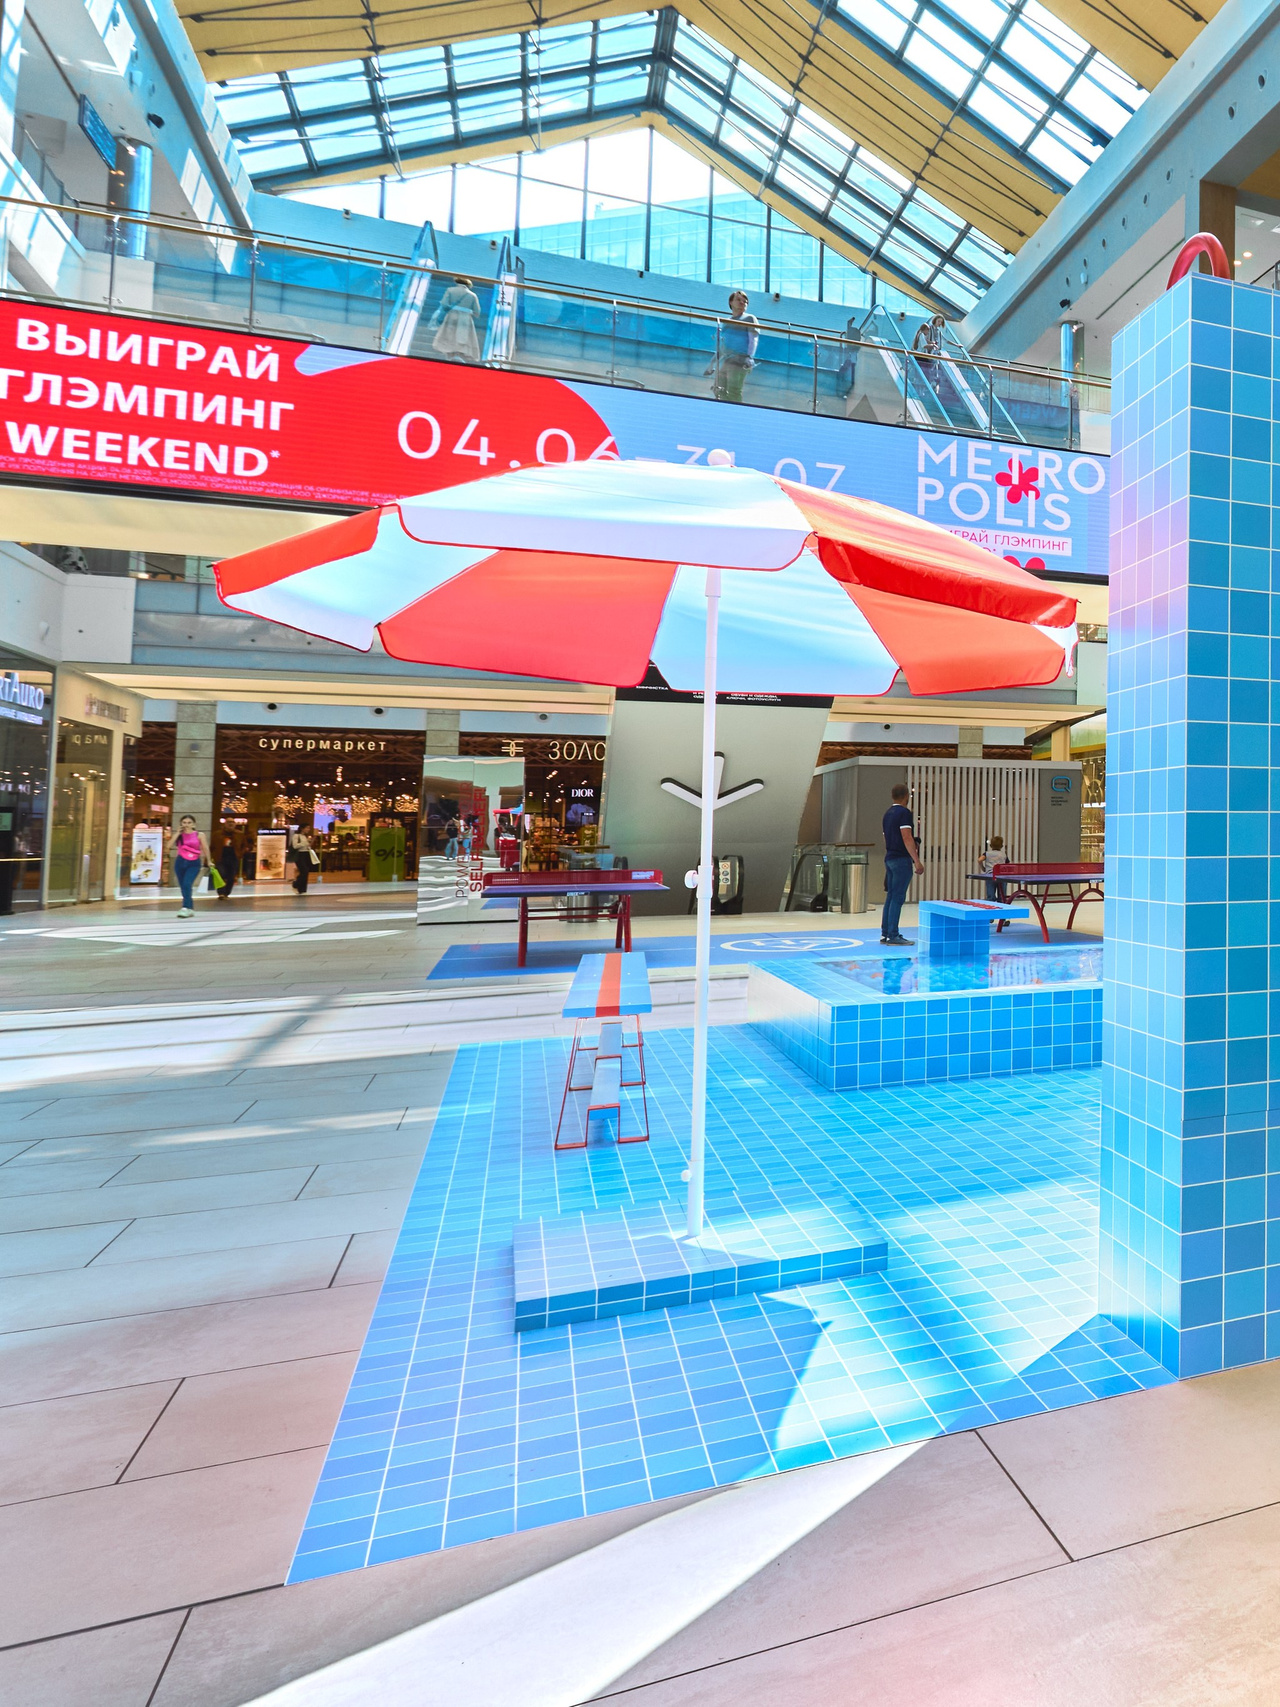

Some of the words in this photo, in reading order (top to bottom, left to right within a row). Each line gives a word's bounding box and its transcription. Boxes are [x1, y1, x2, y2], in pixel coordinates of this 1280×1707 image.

[16, 318, 280, 382] ВЫИГРАЙ
[0, 367, 295, 431] ГЛЭМПИНГ
[20, 463, 74, 474] ПОЛУЧЕНИЯ
[76, 468, 88, 476] НА
[90, 470, 116, 479] САЙТЕ
[210, 482, 263, 493] ОРГАНИЗАТОР
[292, 490, 310, 498] ООО
[918, 434, 1106, 495] METRO
[917, 476, 1071, 532] POLIS
[994, 534, 1068, 551] ГЛЭМПИНГ
[259, 737, 386, 752] супермаркет
[571, 788, 594, 798] DIOR
